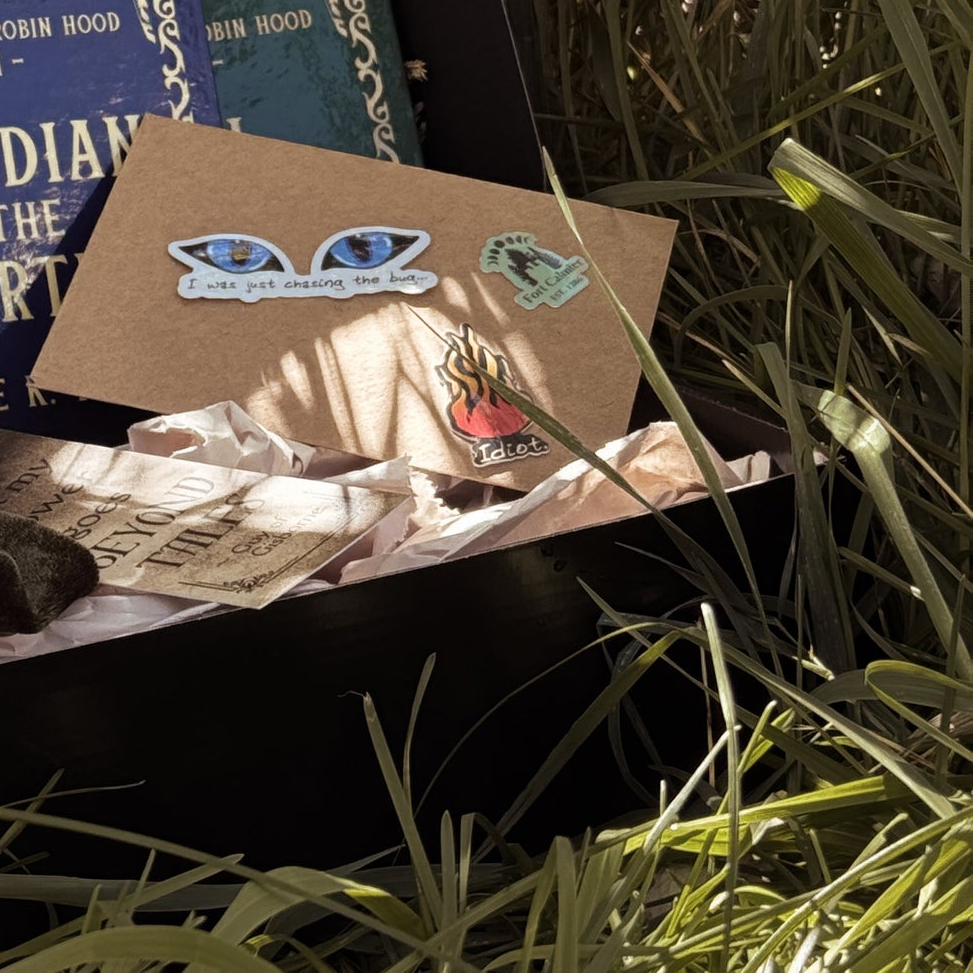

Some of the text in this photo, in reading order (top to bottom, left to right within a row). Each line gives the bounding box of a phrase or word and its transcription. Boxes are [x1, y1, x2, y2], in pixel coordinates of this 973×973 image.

[62, 11, 121, 35] HOOD
[205, 9, 312, 42] BIN HOOD
[187, 277, 196, 290] I
[207, 280, 237, 291] was
[245, 278, 277, 293] just
[284, 276, 346, 292] chasing
[352, 273, 381, 286] the
[523, 284, 548, 303] Fort
